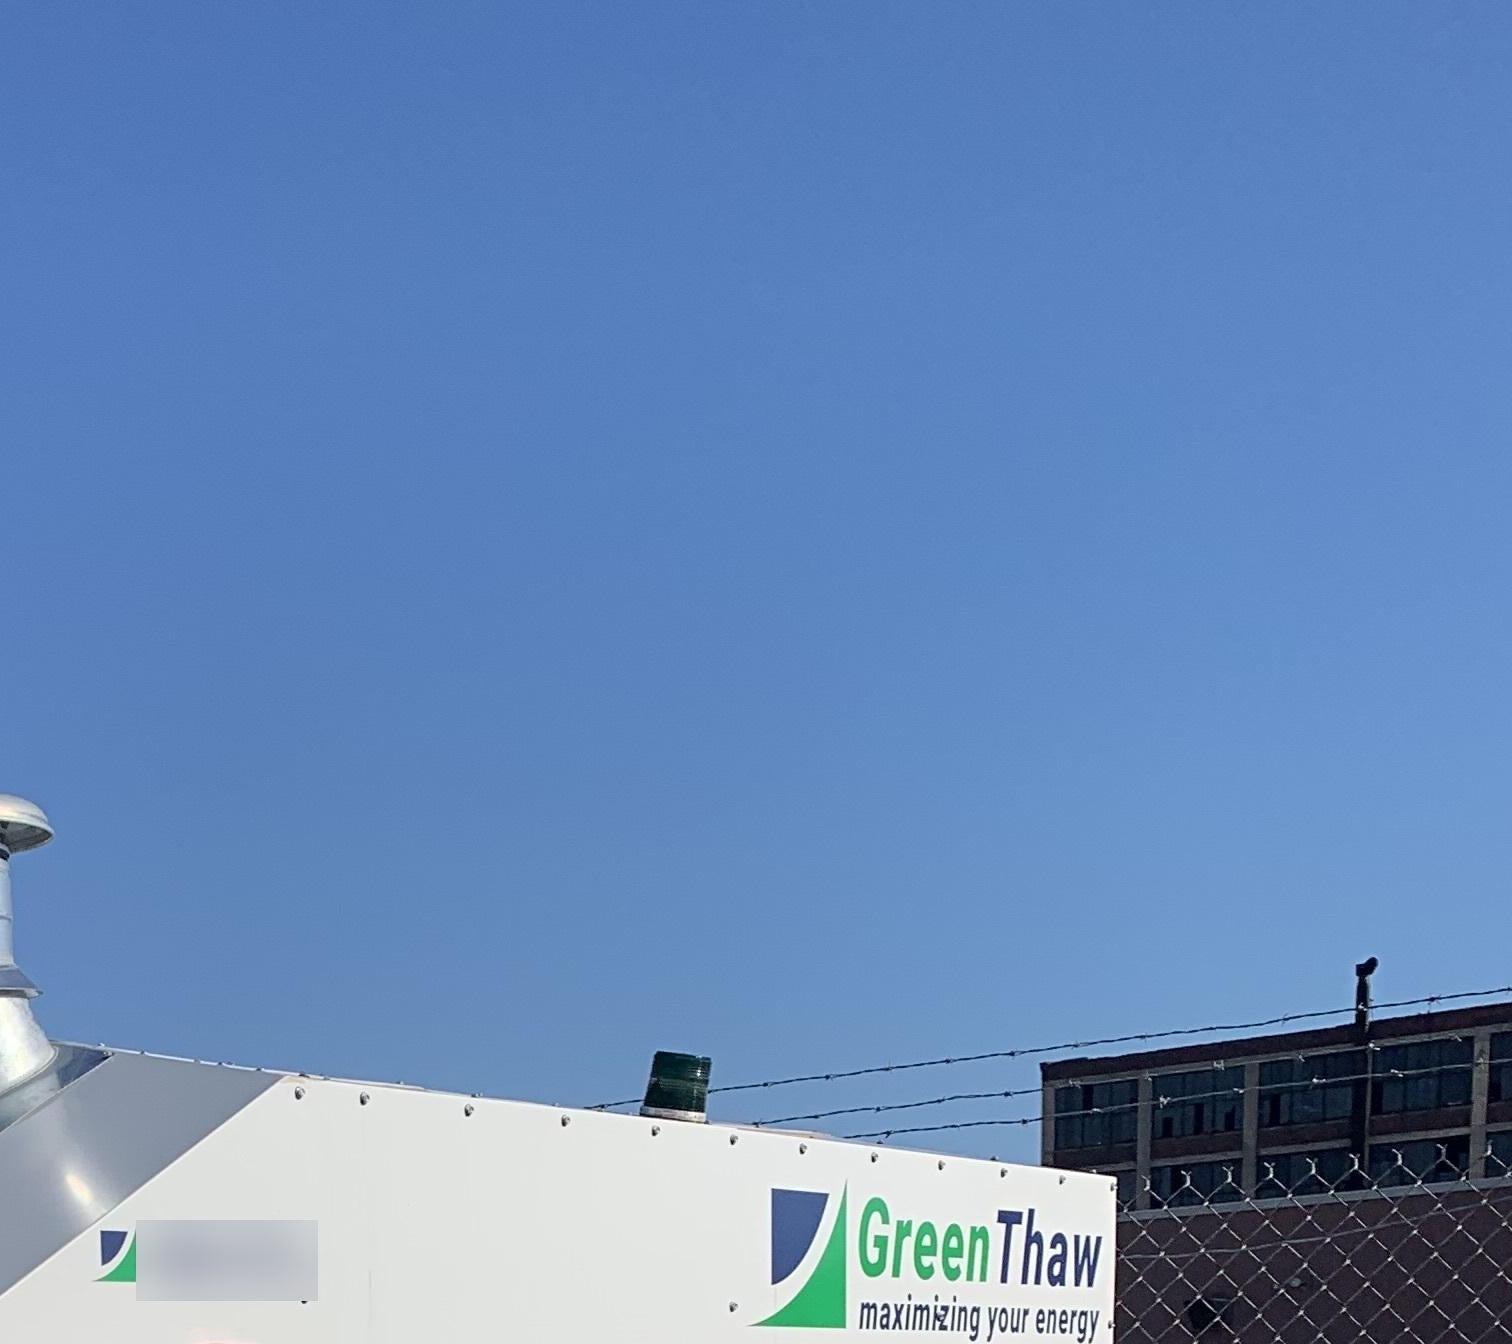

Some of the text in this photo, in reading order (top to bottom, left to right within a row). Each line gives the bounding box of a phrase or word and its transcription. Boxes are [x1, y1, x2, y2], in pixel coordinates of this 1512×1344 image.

[858, 1293, 1100, 1344] maximizing your energy
